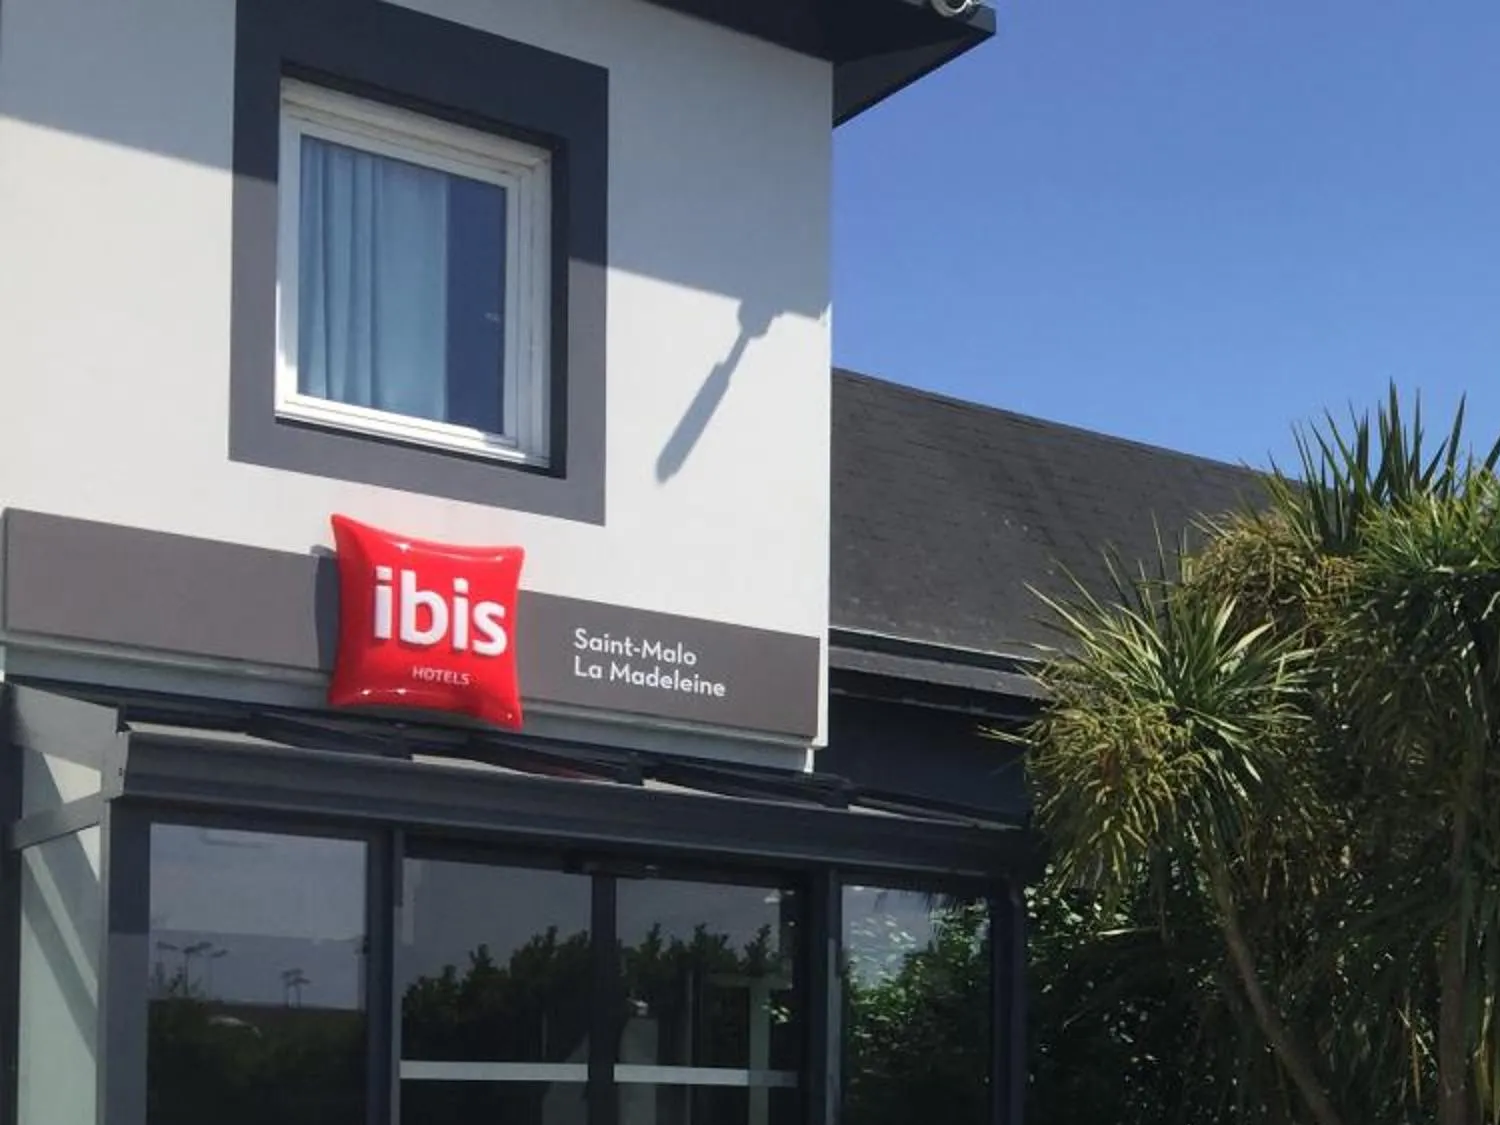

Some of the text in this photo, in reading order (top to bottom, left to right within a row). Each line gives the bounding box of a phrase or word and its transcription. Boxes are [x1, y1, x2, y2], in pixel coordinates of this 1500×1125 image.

[374, 565, 508, 655] ibis
[573, 628, 698, 666] Saint-Malo
[412, 664, 471, 686] HOTELS
[573, 655, 727, 698] La Madeleine
